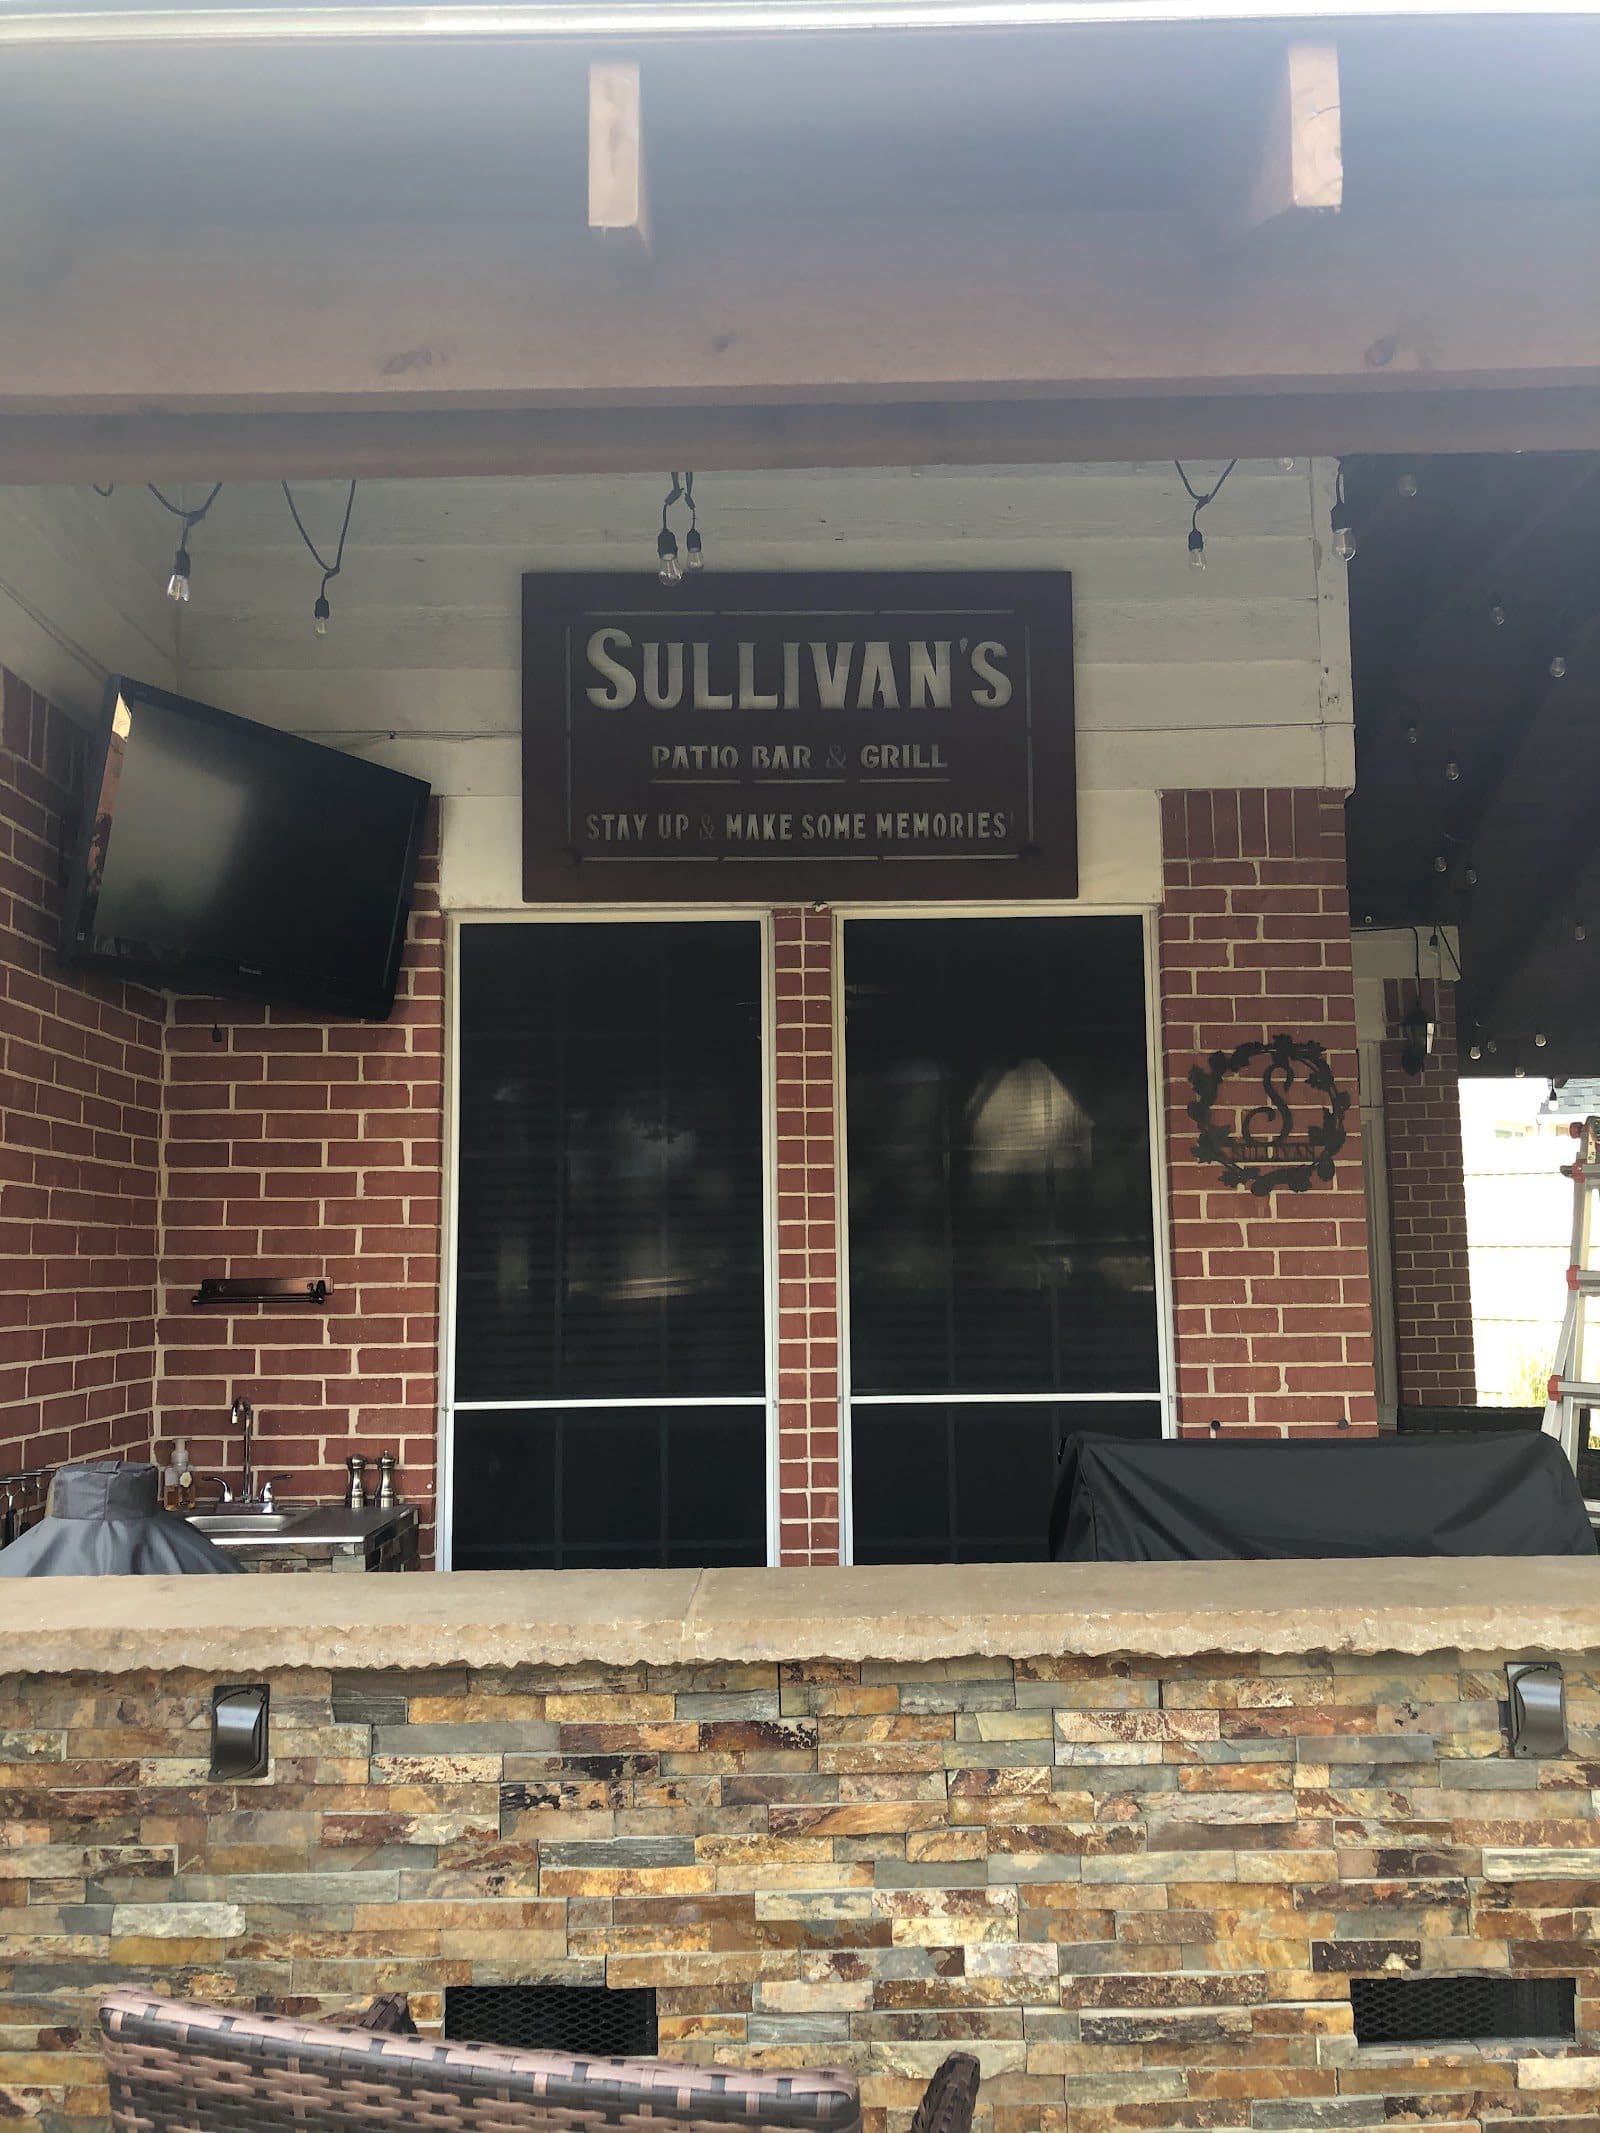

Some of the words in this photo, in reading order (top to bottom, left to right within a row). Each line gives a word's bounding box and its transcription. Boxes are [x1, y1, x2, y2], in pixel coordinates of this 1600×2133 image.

[586, 627, 1013, 710] SULLIVAN'S
[651, 745, 740, 769] PATIO
[752, 745, 812, 769] BAR
[826, 745, 848, 769] &
[860, 744, 948, 769] GRILL
[586, 814, 649, 840] STAY
[657, 814, 689, 840] UP
[726, 814, 793, 840] MAKE
[801, 814, 866, 840] SOME
